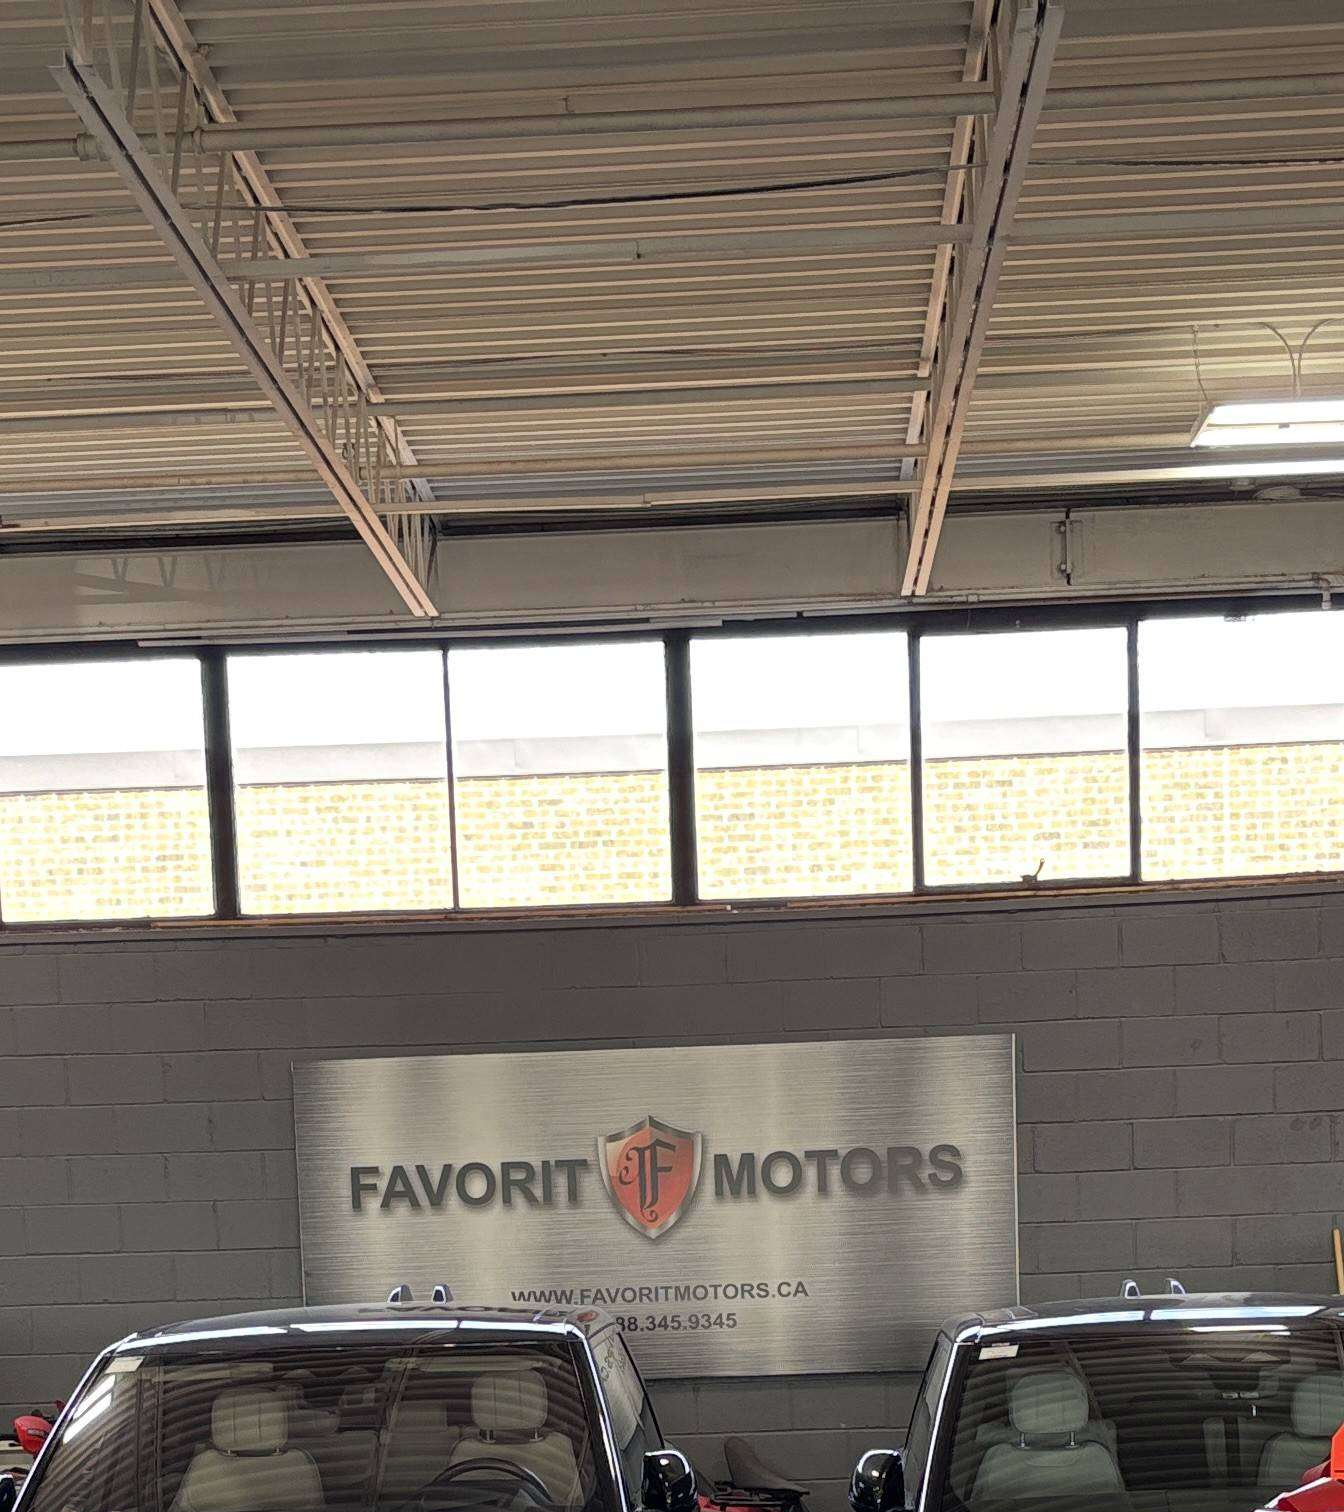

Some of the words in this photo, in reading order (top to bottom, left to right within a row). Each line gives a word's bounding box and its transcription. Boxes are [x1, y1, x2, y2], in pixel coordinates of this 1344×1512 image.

[350, 1159, 588, 1210] FAVORIT
[713, 1144, 963, 1197] MOTORS
[511, 1281, 810, 1305] WWW.FAVORITMOTORS.CA
